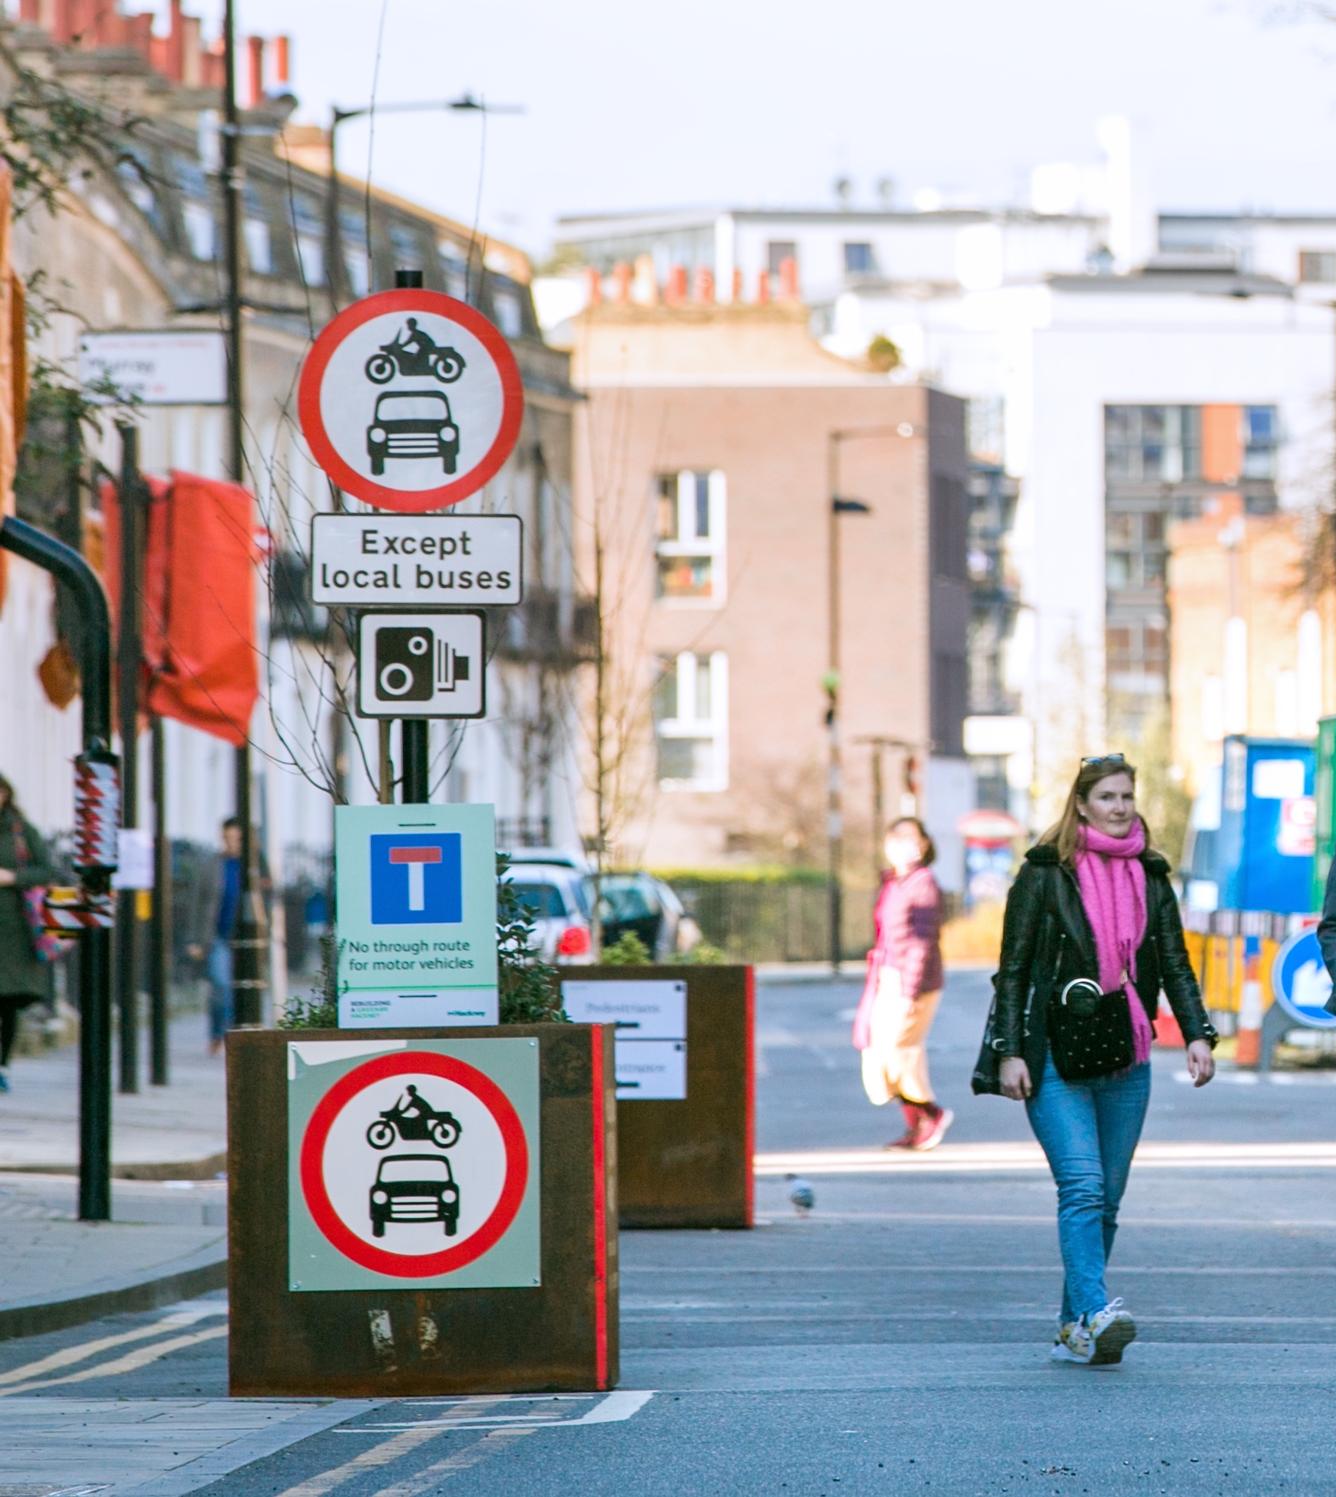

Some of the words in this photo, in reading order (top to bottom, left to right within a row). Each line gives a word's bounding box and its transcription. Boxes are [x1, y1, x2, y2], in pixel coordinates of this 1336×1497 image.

[361, 529, 472, 560] Except
[321, 563, 402, 588] local
[416, 563, 511, 589] buses
[349, 941, 369, 953] No
[373, 940, 429, 955] through
[433, 940, 471, 951] route
[350, 958, 369, 971] for
[372, 959, 416, 970] motor
[419, 957, 475, 970] vehicles
